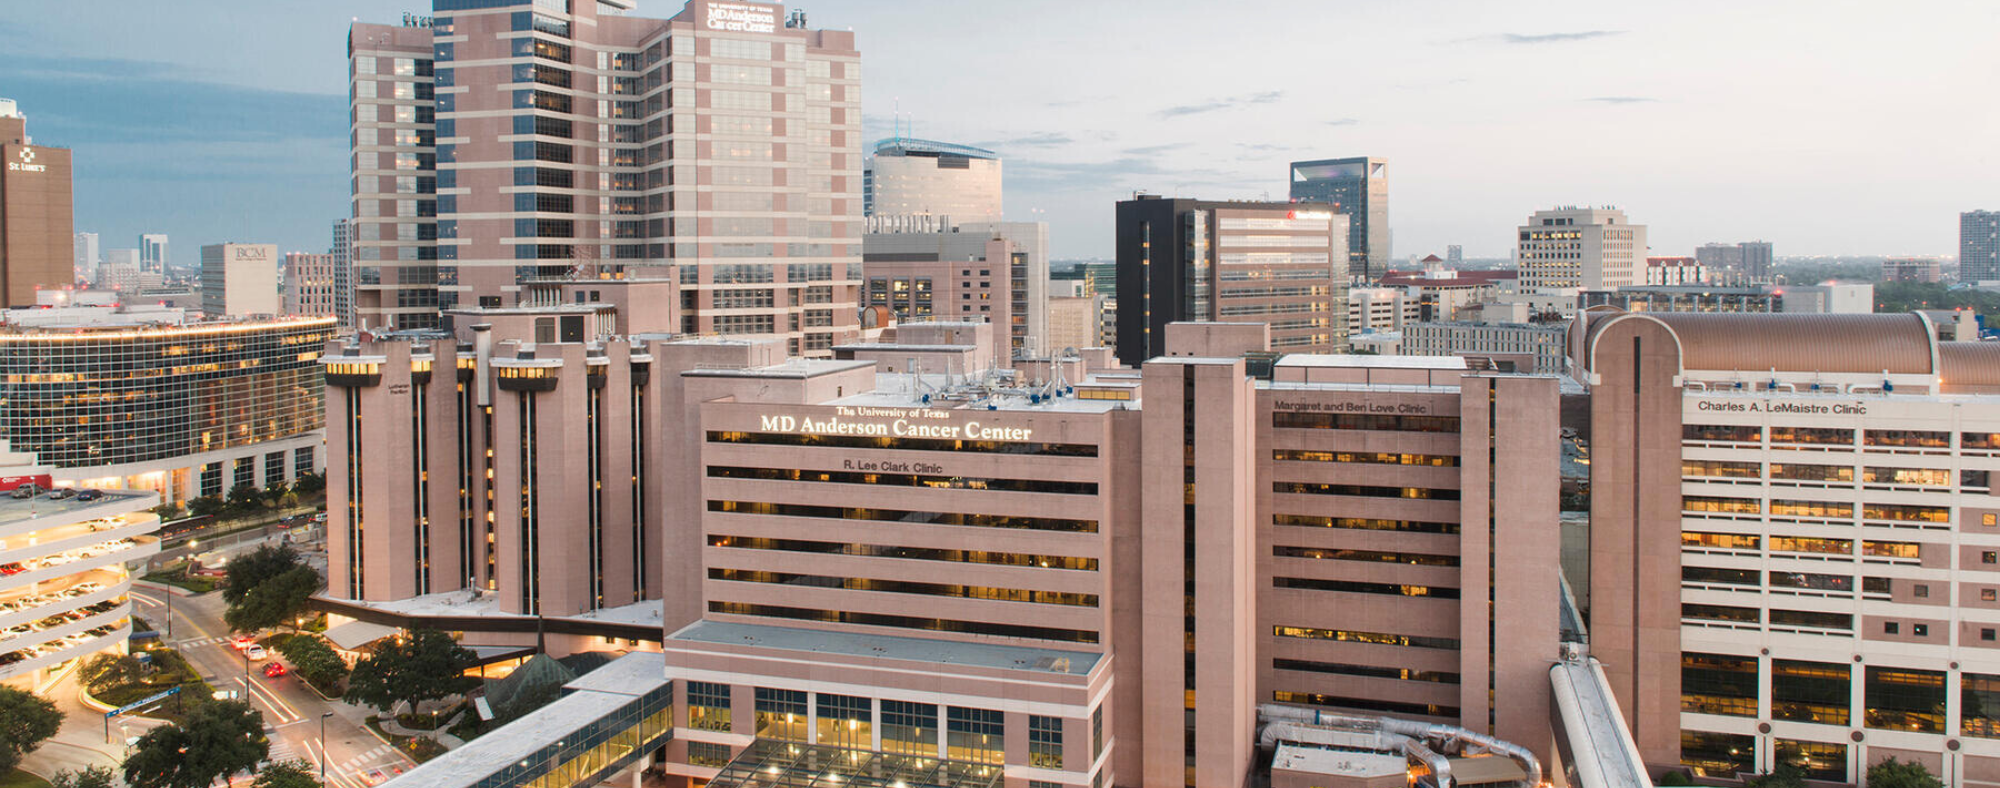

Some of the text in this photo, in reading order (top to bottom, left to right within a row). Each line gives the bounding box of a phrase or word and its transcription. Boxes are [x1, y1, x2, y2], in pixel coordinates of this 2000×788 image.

[708, 8, 774, 23] MD Anderson
[743, 20, 775, 33] Center
[235, 247, 267, 258] BCM
[836, 406, 950, 418] The University of Texas
[1274, 401, 1427, 413] Margaret and Ben Love Clinic
[1698, 400, 1867, 415] Charles A. LeMaistre Clinic
[761, 415, 1032, 440] MD Anderson Cancer Center
[844, 460, 943, 473] R. Lee Clark Clinic
